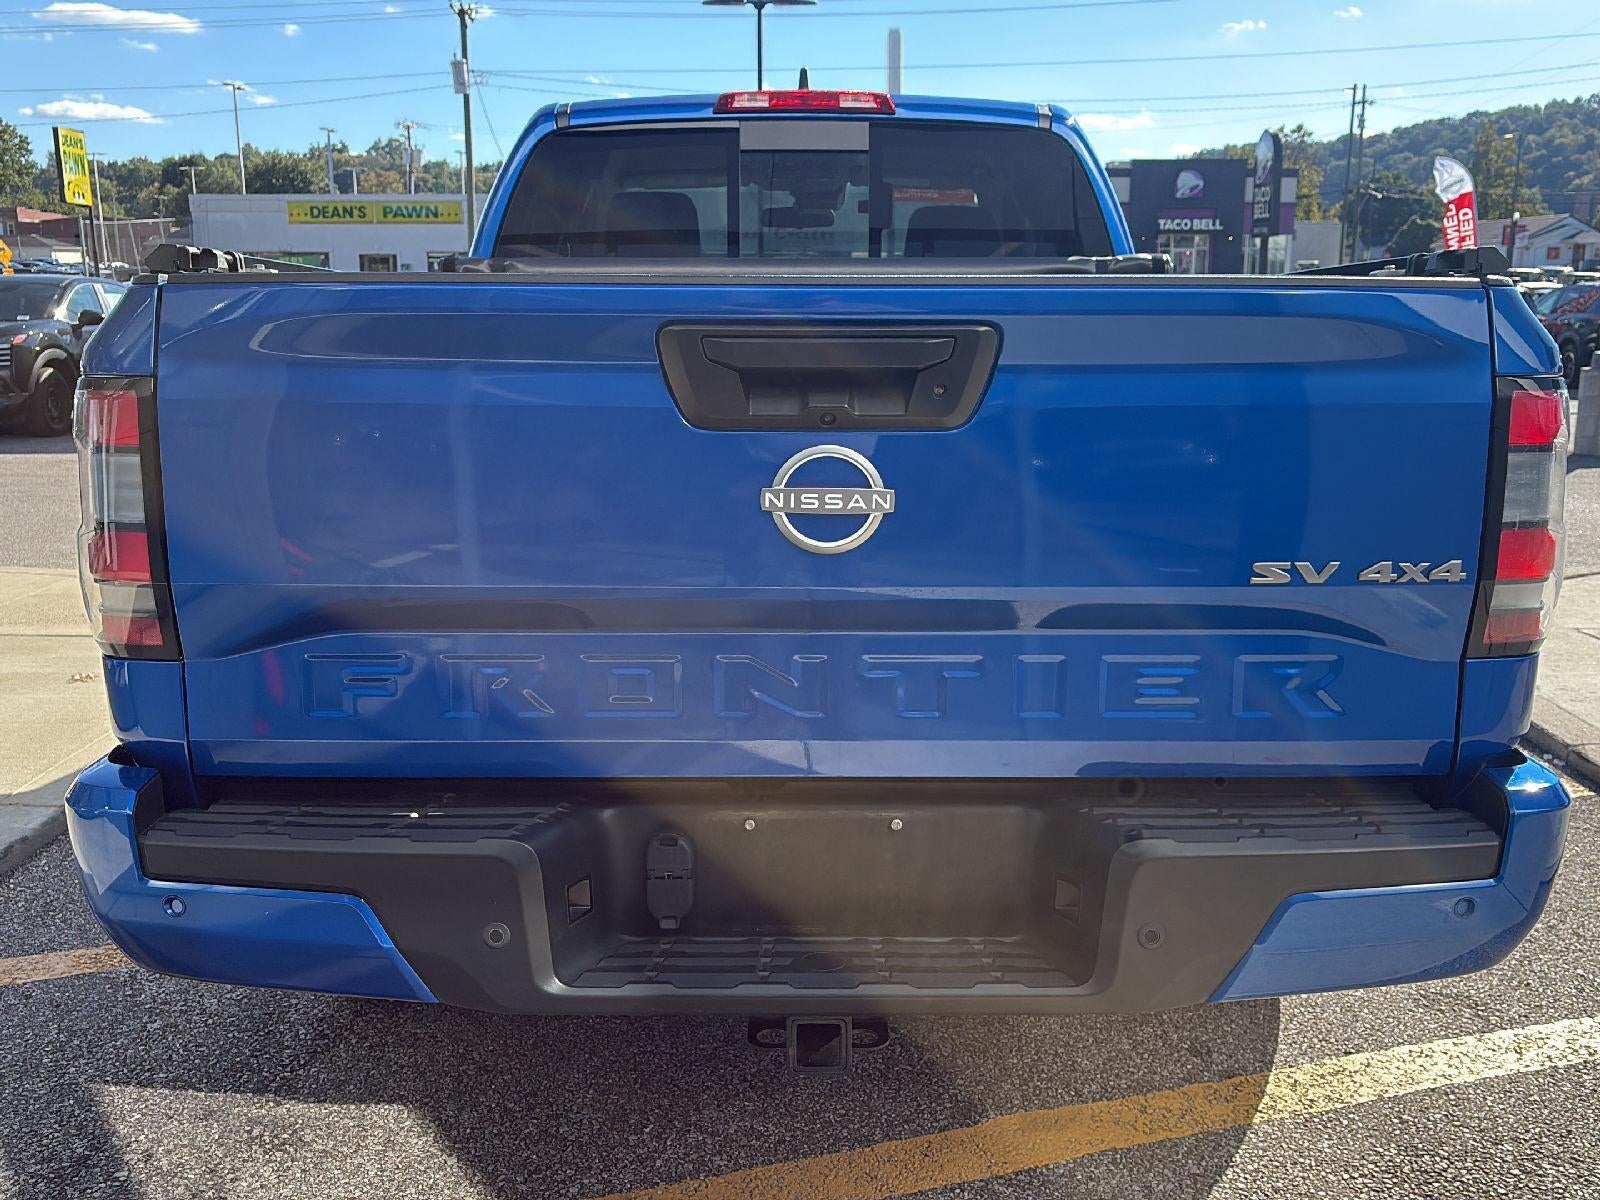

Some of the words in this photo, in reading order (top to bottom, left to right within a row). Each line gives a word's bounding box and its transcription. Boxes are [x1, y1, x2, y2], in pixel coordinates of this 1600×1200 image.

[63, 149, 87, 178] PAWN
[309, 205, 367, 219] DEAN'S
[382, 205, 440, 219] PAWN
[1253, 203, 1270, 219] BELL
[1158, 218, 1190, 230] TACO
[1192, 219, 1224, 230] BELL
[764, 492, 891, 510] NISSAN
[1249, 561, 1341, 584] SV
[1357, 559, 1467, 583] 4x4
[302, 652, 1345, 719] FRONTIER
